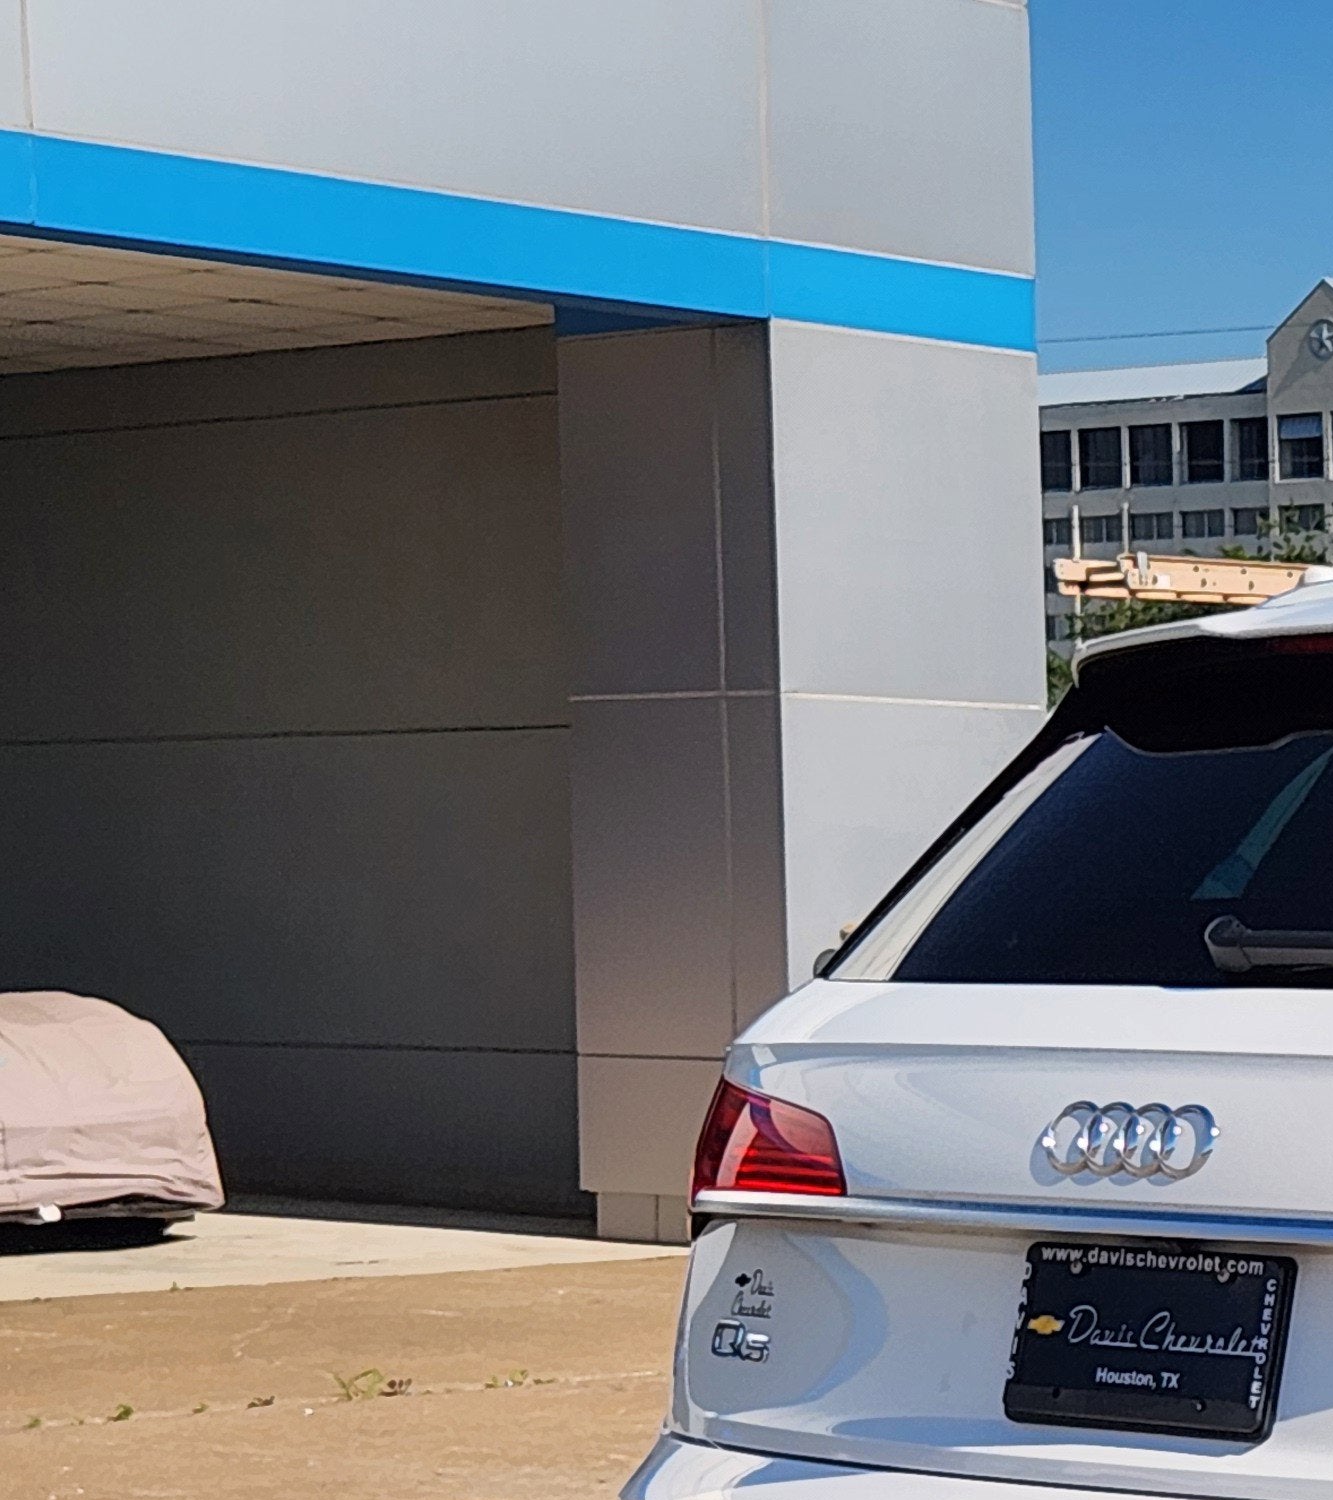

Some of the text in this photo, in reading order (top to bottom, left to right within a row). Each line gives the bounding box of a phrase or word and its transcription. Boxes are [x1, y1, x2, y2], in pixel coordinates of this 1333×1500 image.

[1041, 1247, 1265, 1275] www.davischevrolet.com
[711, 1318, 771, 1362] Q5
[1067, 1304, 1263, 1357] Davis Chevrolet
[1250, 1278, 1277, 1409] CHEVROLET
[1095, 1366, 1181, 1390] Houston, TX
